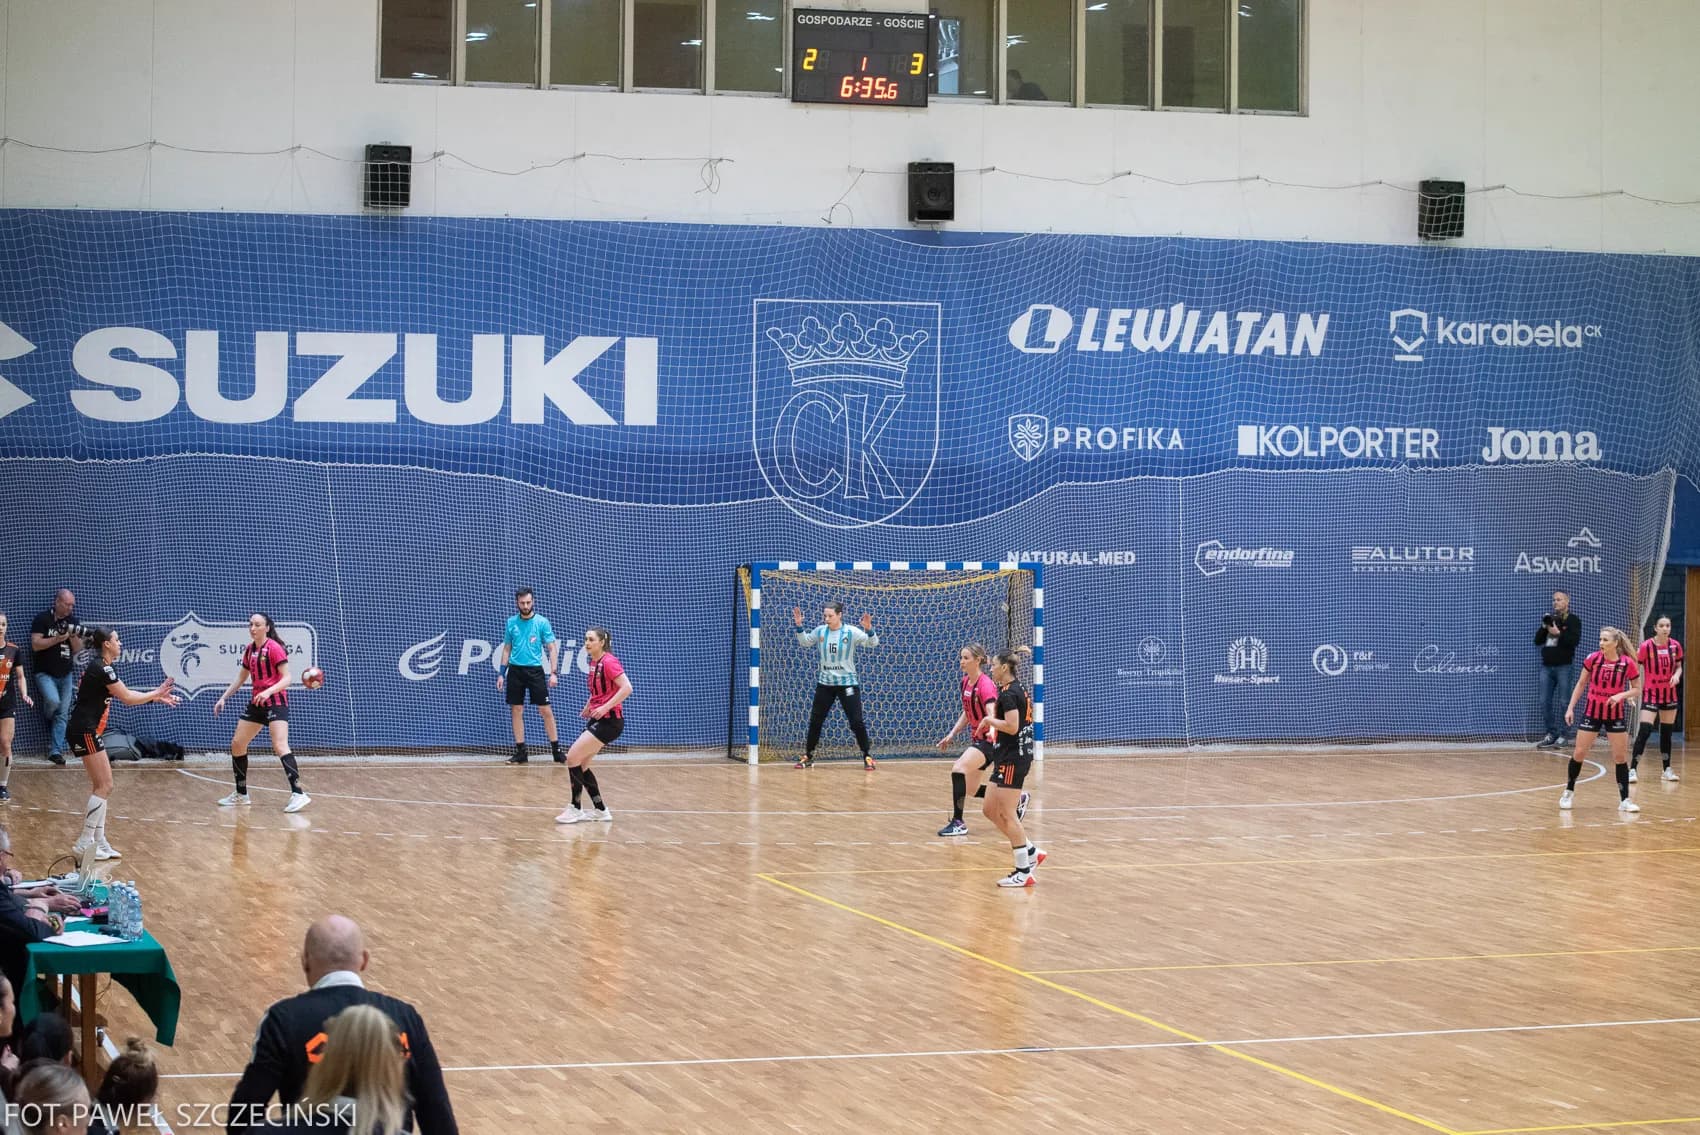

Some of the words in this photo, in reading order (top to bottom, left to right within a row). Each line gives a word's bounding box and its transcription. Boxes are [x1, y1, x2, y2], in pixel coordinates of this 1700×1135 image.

[797, 14, 873, 27] GOSPODARZE
[883, 15, 925, 29] GOŚCIE
[802, 48, 818, 71] 2
[861, 56, 868, 72] 1
[910, 52, 924, 75] 3
[1077, 302, 1329, 356] LEWIATAN
[70, 326, 658, 426] SUZUKI
[774, 390, 906, 499] CK
[1053, 425, 1184, 451] PROFIKA
[1258, 425, 1439, 460] KOLPORTER
[1482, 427, 1602, 462] Joma
[1006, 550, 1136, 566] NATURAL-MED
[1204, 547, 1294, 561] endorfina
[1370, 546, 1473, 560] ALUTOR
[1513, 551, 1602, 573] Aswent
[829, 643, 838, 654] 16
[1659, 656, 1669, 668] 10
[1602, 668, 1612, 681] 13
